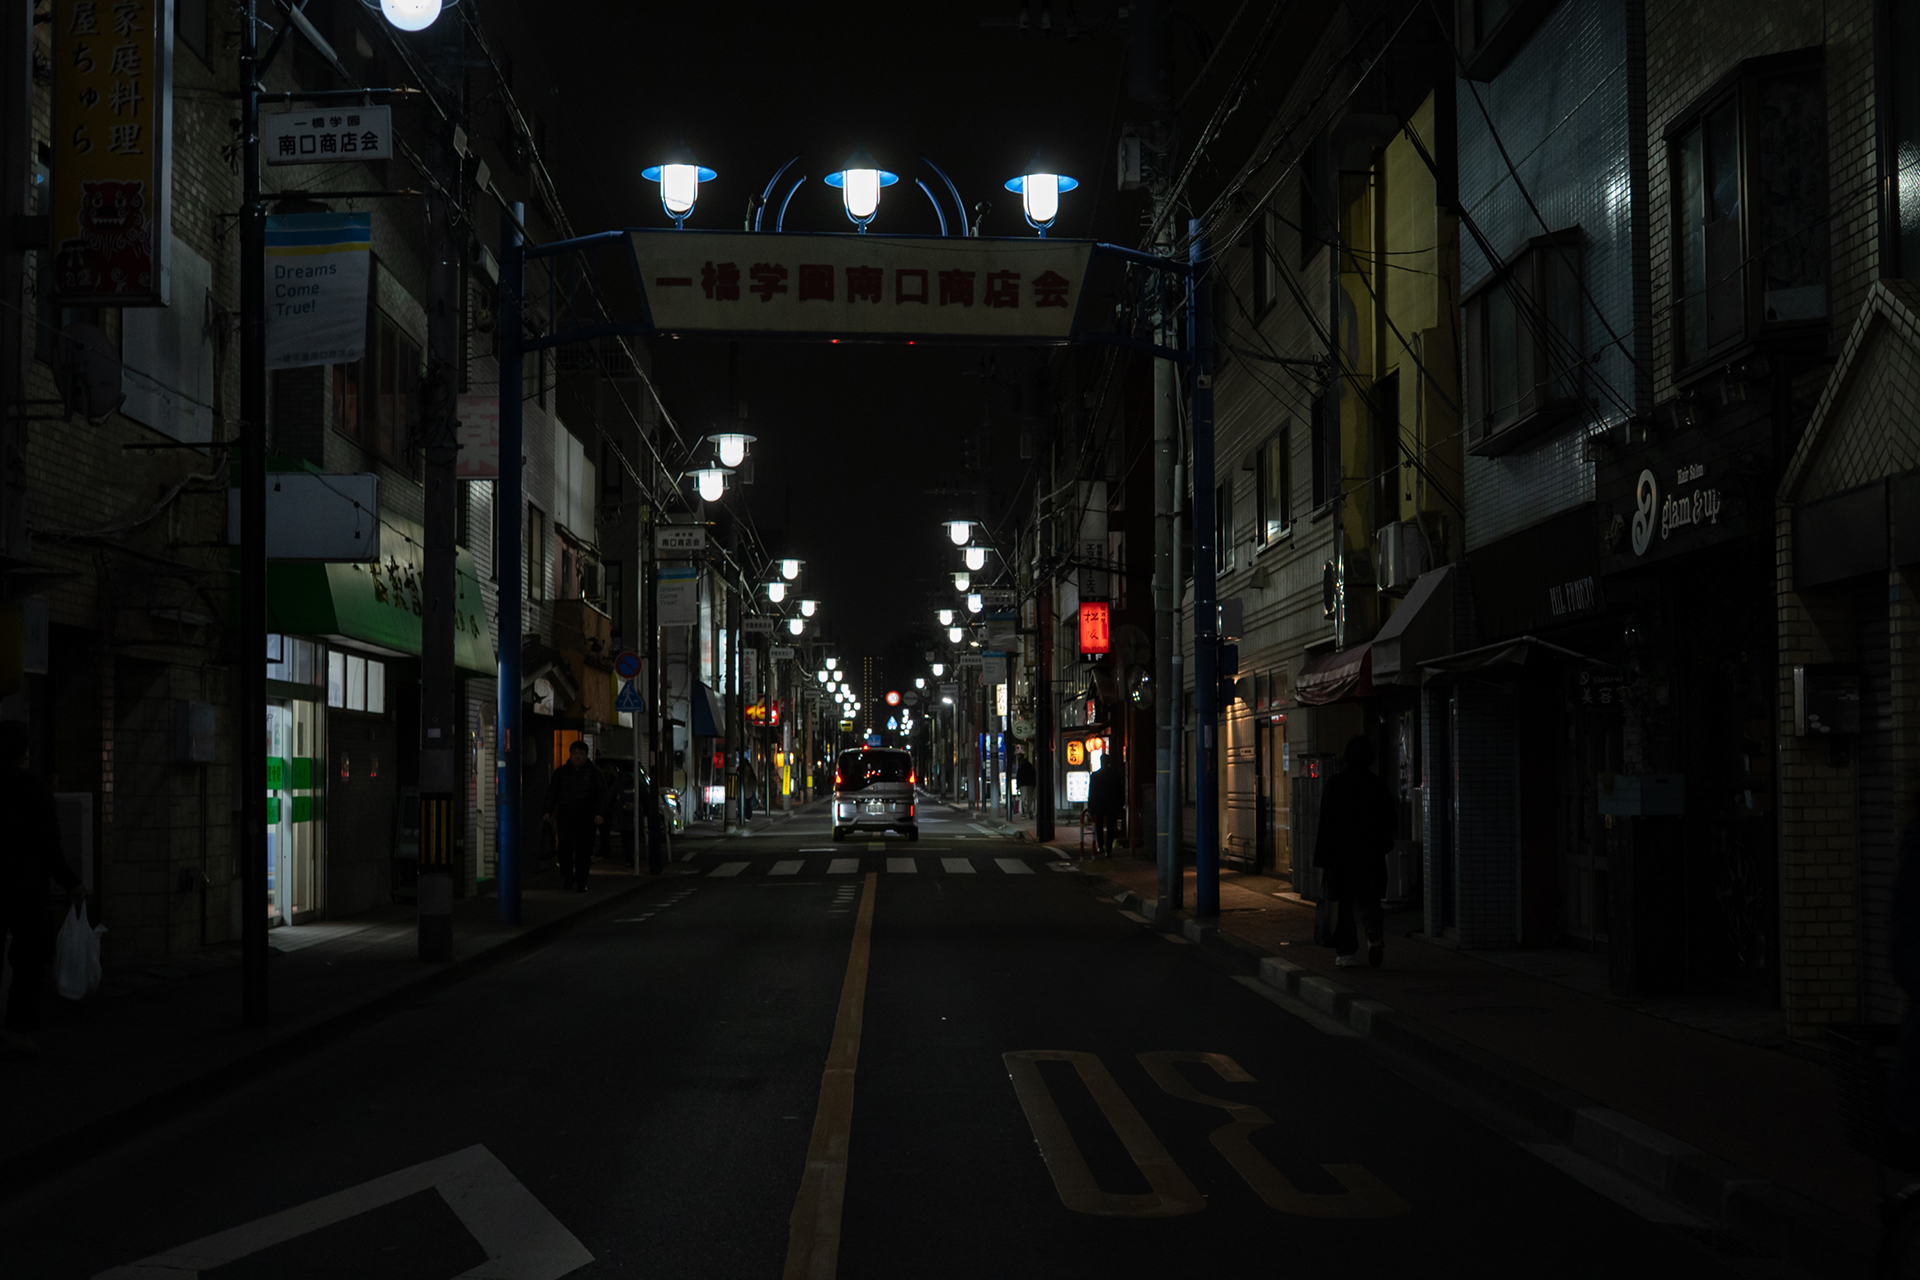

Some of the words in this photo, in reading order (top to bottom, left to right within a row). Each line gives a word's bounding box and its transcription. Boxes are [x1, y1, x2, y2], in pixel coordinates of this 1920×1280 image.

[108, 0, 146, 155] 家庭料理
[294, 114, 361, 129] 一橋学園
[278, 131, 379, 156] 南口商店会
[274, 264, 337, 280] Dreams
[275, 283, 320, 298] Come
[656, 261, 1070, 308] 一橋学園南口商店会
[276, 300, 316, 316] True!
